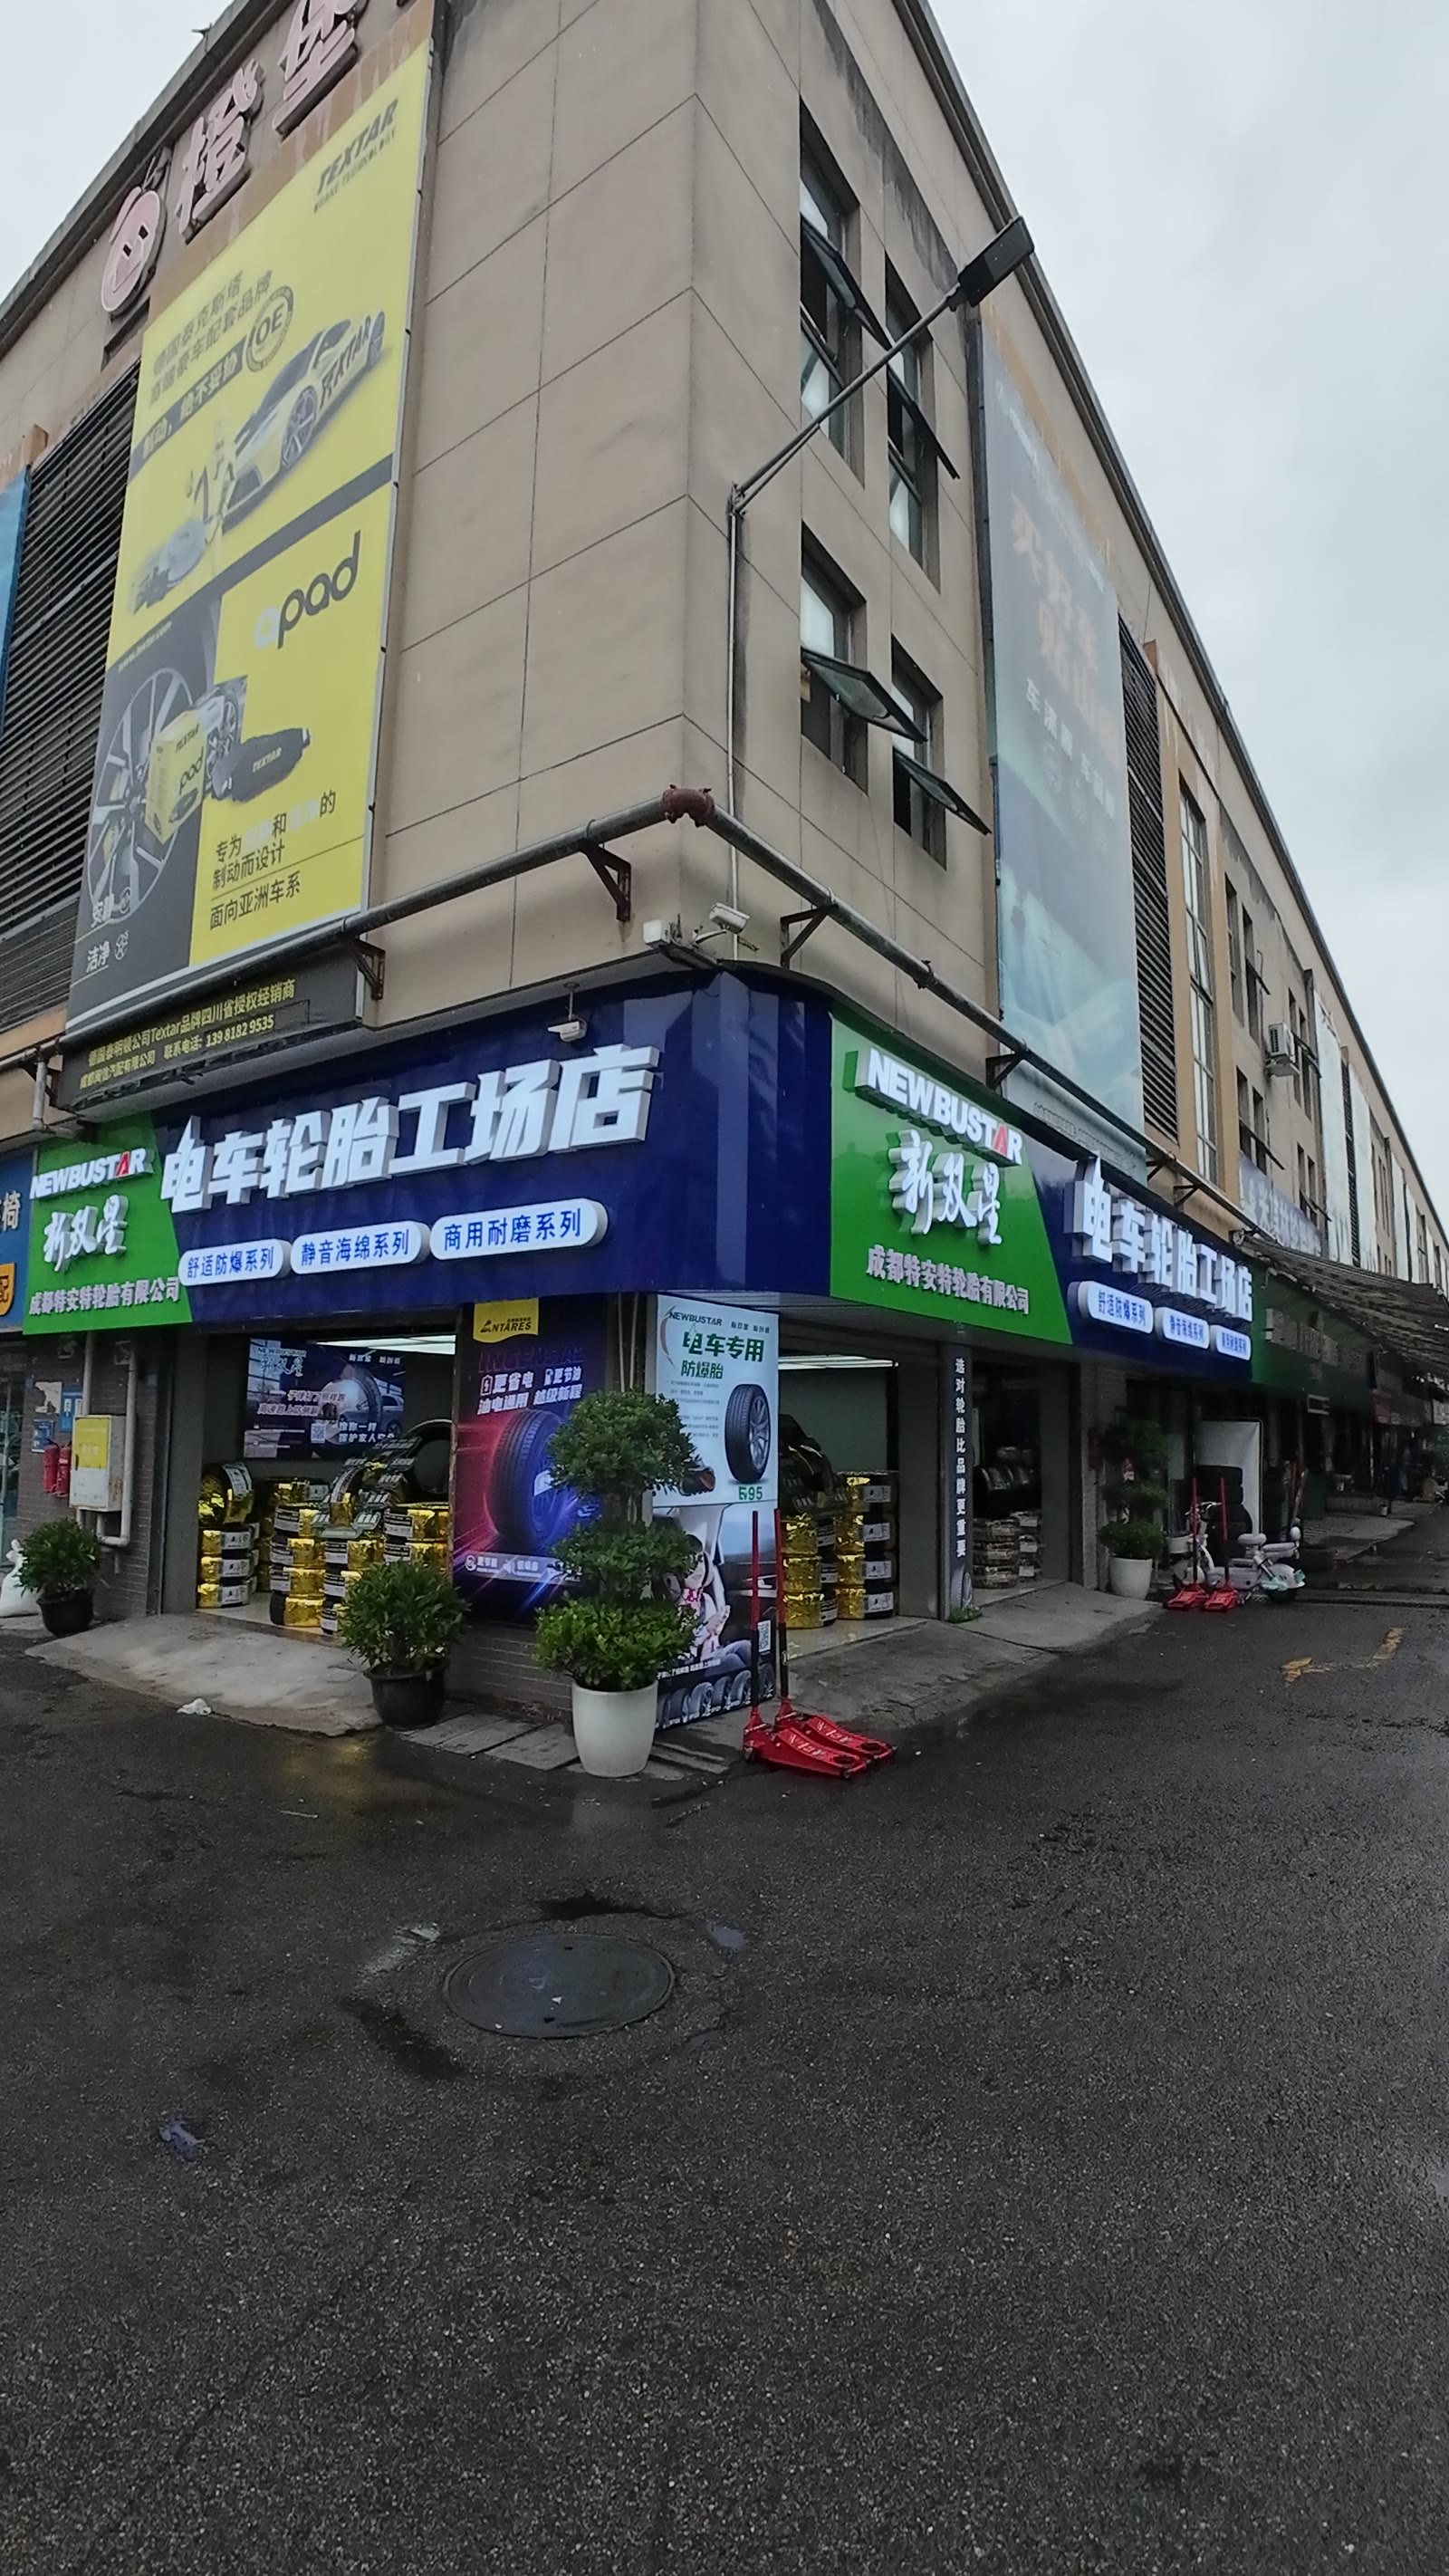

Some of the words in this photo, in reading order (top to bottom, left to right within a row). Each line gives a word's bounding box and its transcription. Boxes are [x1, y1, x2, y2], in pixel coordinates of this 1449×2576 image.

[317, 97, 399, 197] TEXTAR
[255, 302, 285, 346] OE
[213, 839, 286, 892] 制动而设计
[209, 870, 302, 931] 面向亚洲车系
[206, 1029, 224, 1049] 139
[225, 1021, 248, 1043] 8182
[249, 1014, 275, 1035] 9535
[160, 1043, 660, 1214] 电车轮胎工场店
[860, 1047, 1024, 1167] NEWBUSTAR
[29, 1147, 152, 1200] NEWBUSTAR
[300, 1228, 410, 1267] 静音海绵系列
[443, 1206, 582, 1252] 商用耐磨系列
[1076, 1150, 1254, 1323] 电车轮胎工场店
[187, 1245, 275, 1279] 舒适防爆系列
[866, 1243, 1031, 1316] 成都特安特轮胎有限公司
[29, 1275, 181, 1316] 成都特安特轮胎有限公司
[480, 1320, 532, 1333] ANTARES
[668, 1312, 724, 1327] NEWBUSTAR
[682, 1326, 765, 1362] 电车专用
[492, 1370, 535, 1395] 更省电
[680, 1360, 724, 1380] 防爆胎
